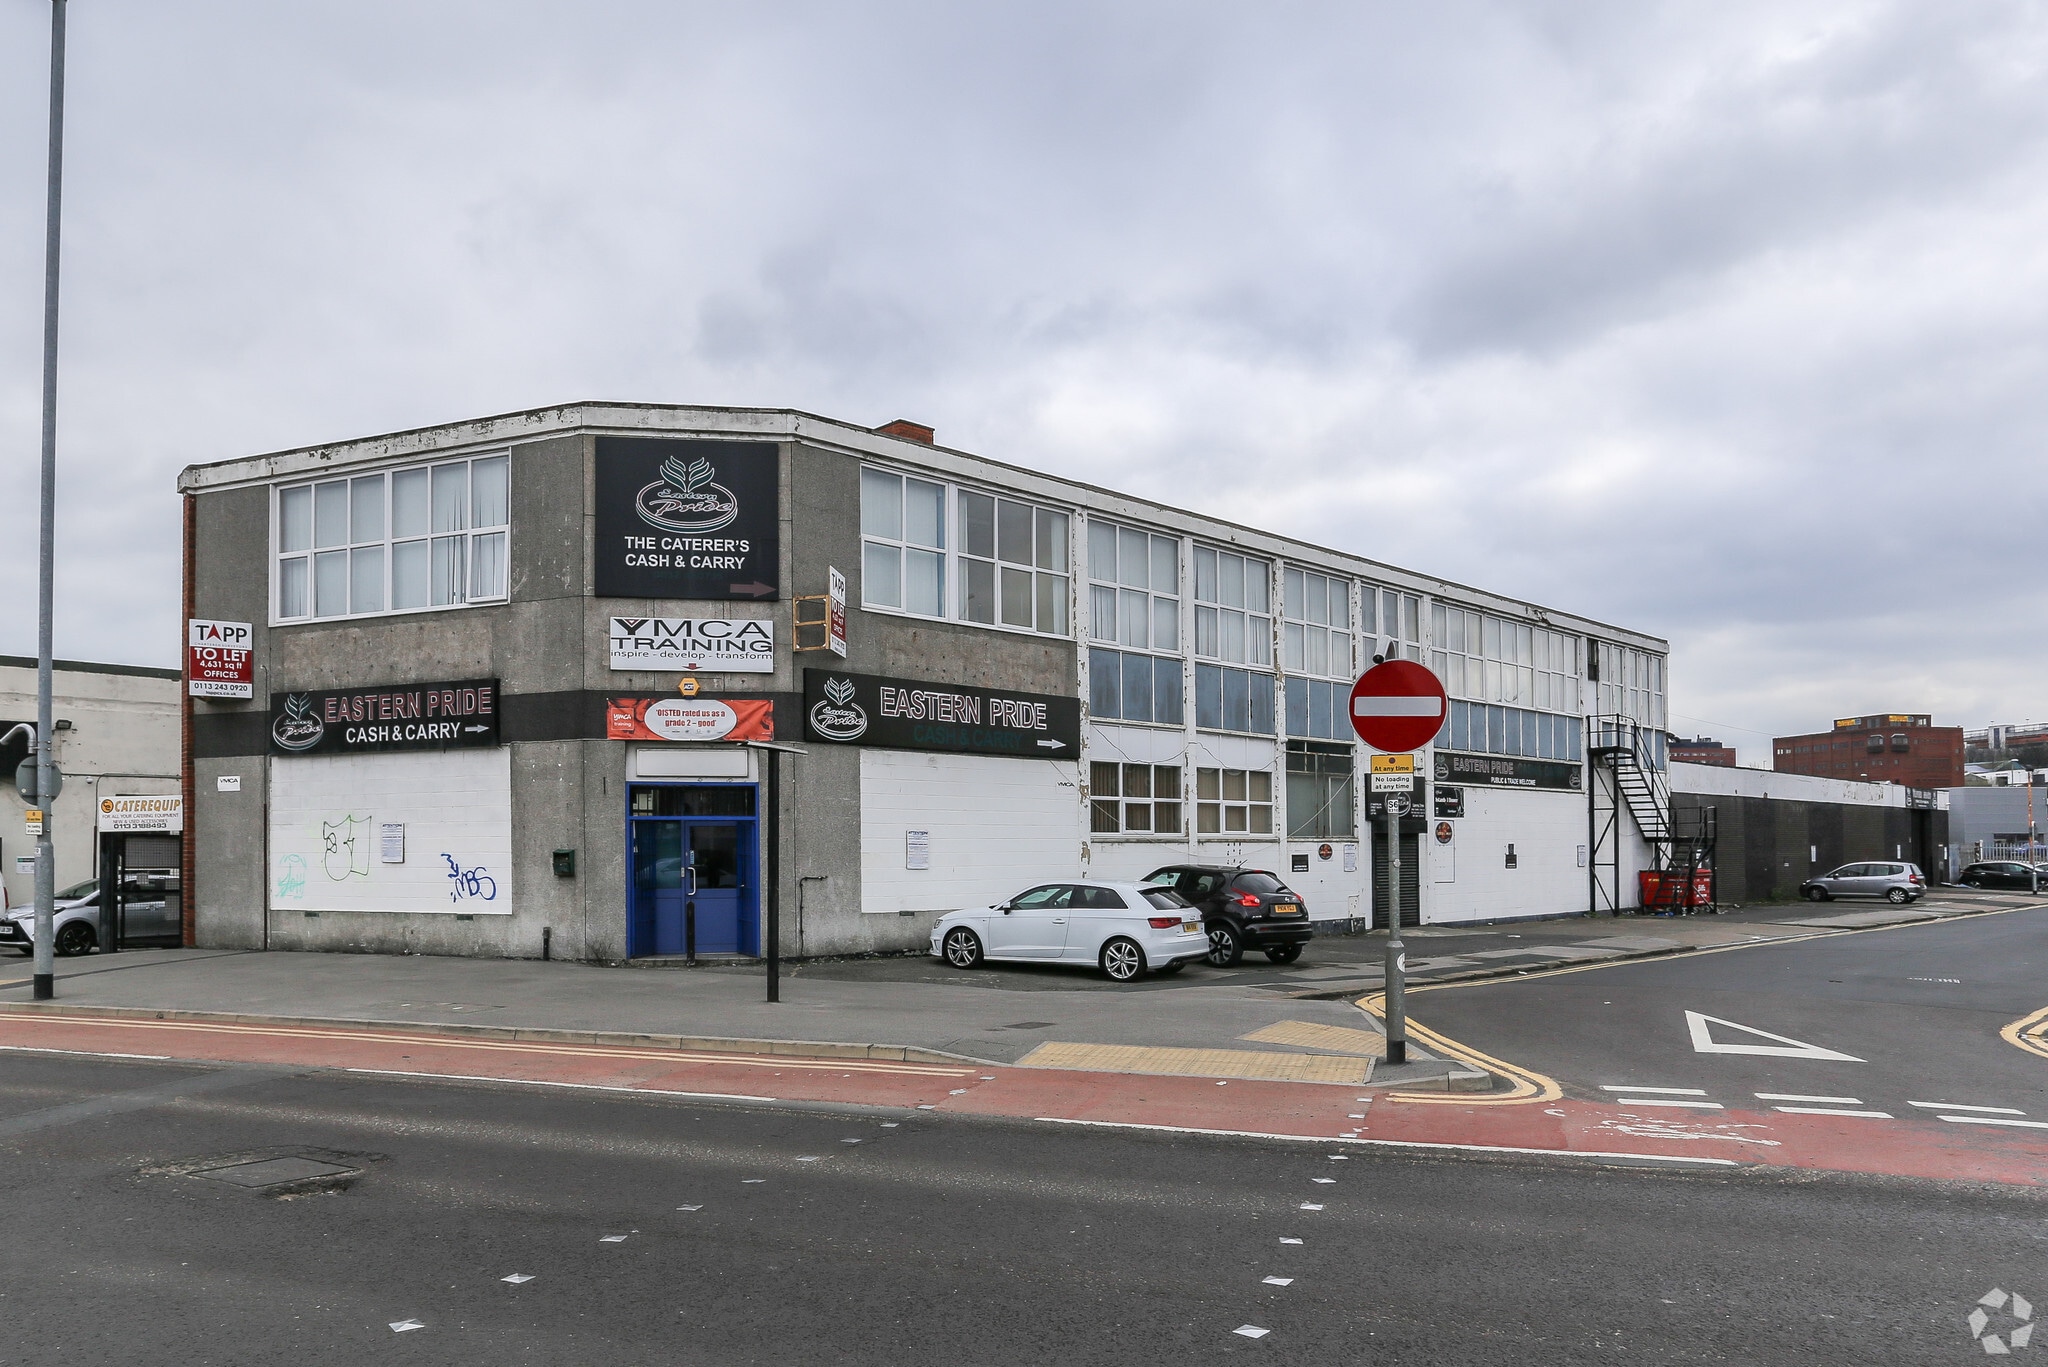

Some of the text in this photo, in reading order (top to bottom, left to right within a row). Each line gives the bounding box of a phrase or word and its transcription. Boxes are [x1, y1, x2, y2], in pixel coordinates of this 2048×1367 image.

[658, 488, 717, 500] Eastern
[649, 499, 732, 517] Pride
[624, 536, 750, 552] THE CATERER'S
[625, 553, 745, 570] CASH & CARRY
[195, 623, 247, 642] TAPP
[614, 618, 770, 639] YMCA
[611, 637, 772, 652] TRAINING
[194, 647, 248, 662] TO LET
[660, 650, 706, 660] develop
[716, 651, 773, 660] transform
[200, 660, 222, 668] 4,631
[204, 670, 238, 678] OFFICES
[194, 682, 213, 690] 0113
[324, 687, 492, 723] EASTERN PRIDE
[880, 686, 1047, 730] EASTERN PRIDE
[818, 714, 865, 728] Pride
[346, 722, 461, 743] CASH & CARRY
[914, 724, 956, 745] CASH
[973, 730, 1022, 750] CARRY
[1453, 757, 1490, 774] EASTERN
[1491, 761, 1514, 775] PRIDE
[115, 800, 181, 812] CATEREQUIP
